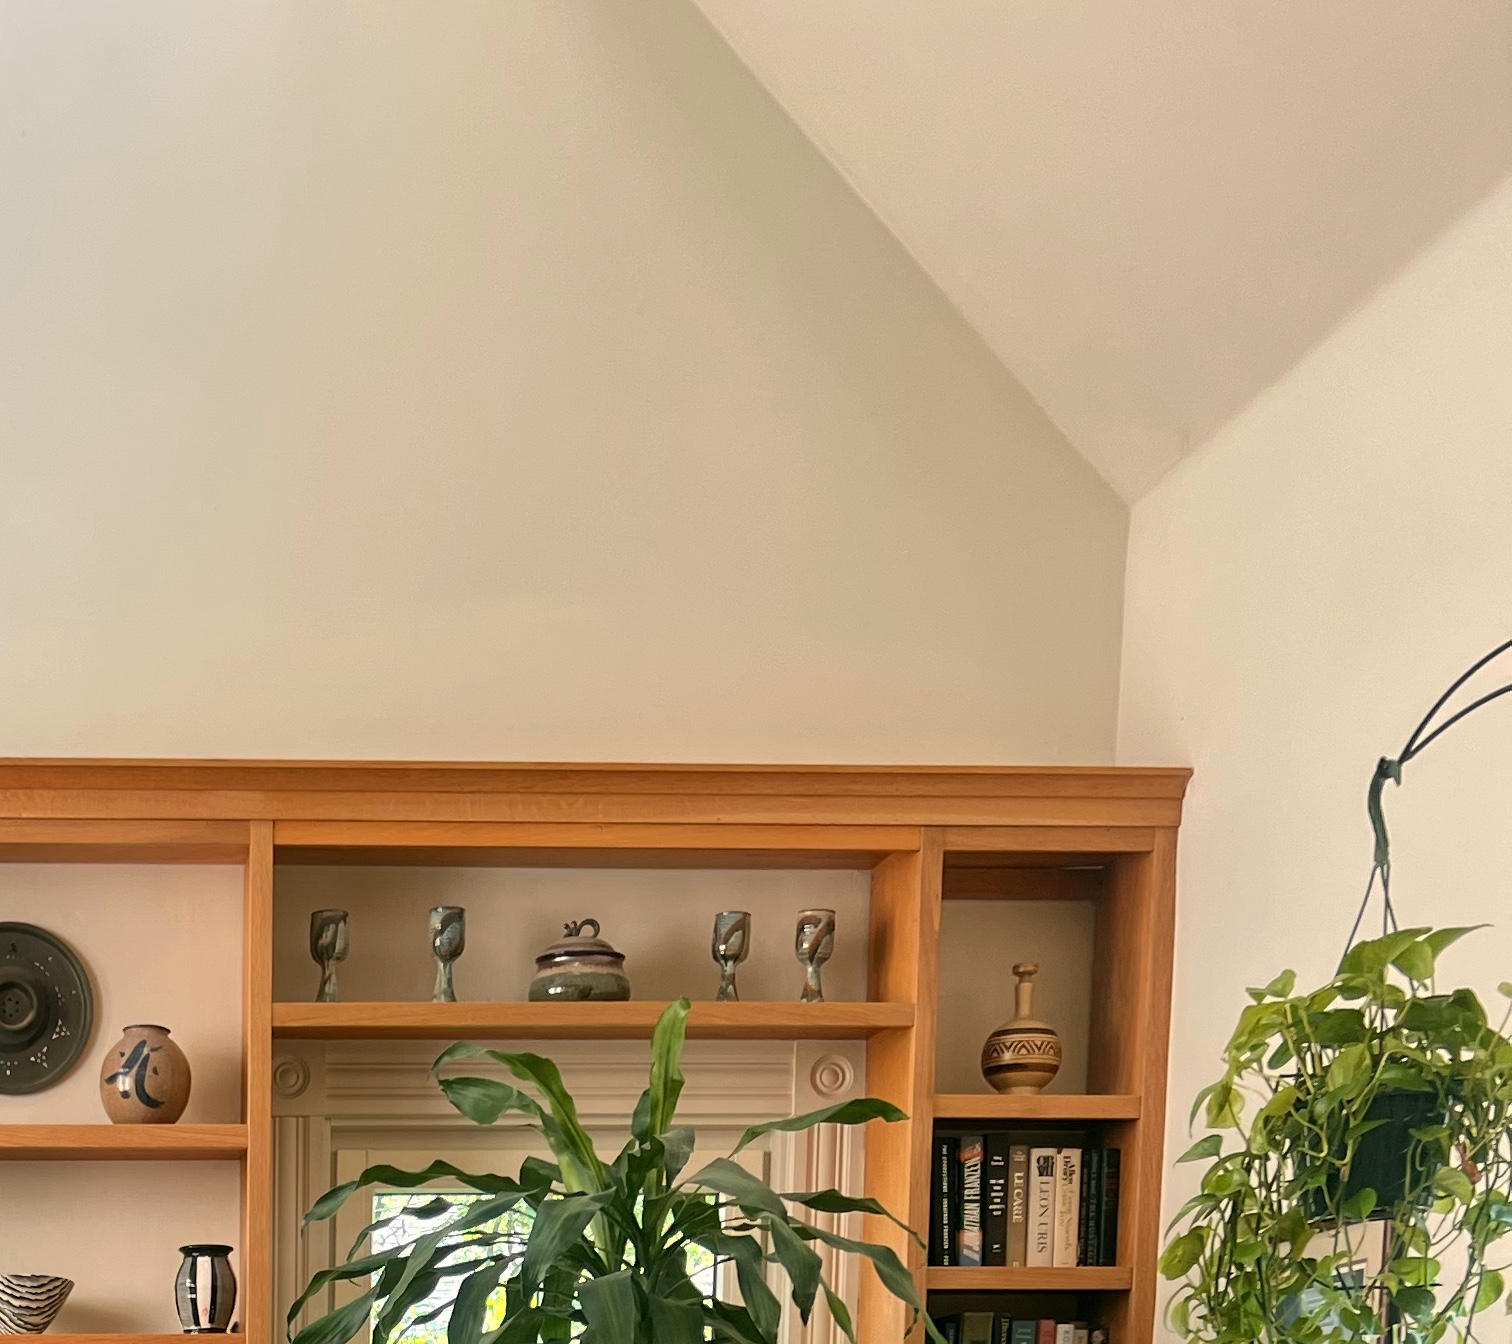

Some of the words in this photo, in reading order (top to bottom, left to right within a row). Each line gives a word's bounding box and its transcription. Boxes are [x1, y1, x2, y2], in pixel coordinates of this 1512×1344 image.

[963, 1155, 981, 1200] FRANZEN
[1068, 1163, 1076, 1185] Allen
[1039, 1181, 1051, 1218] LEON
[963, 1203, 980, 1252] JONATHAN
[1037, 1222, 1049, 1253] URIS
